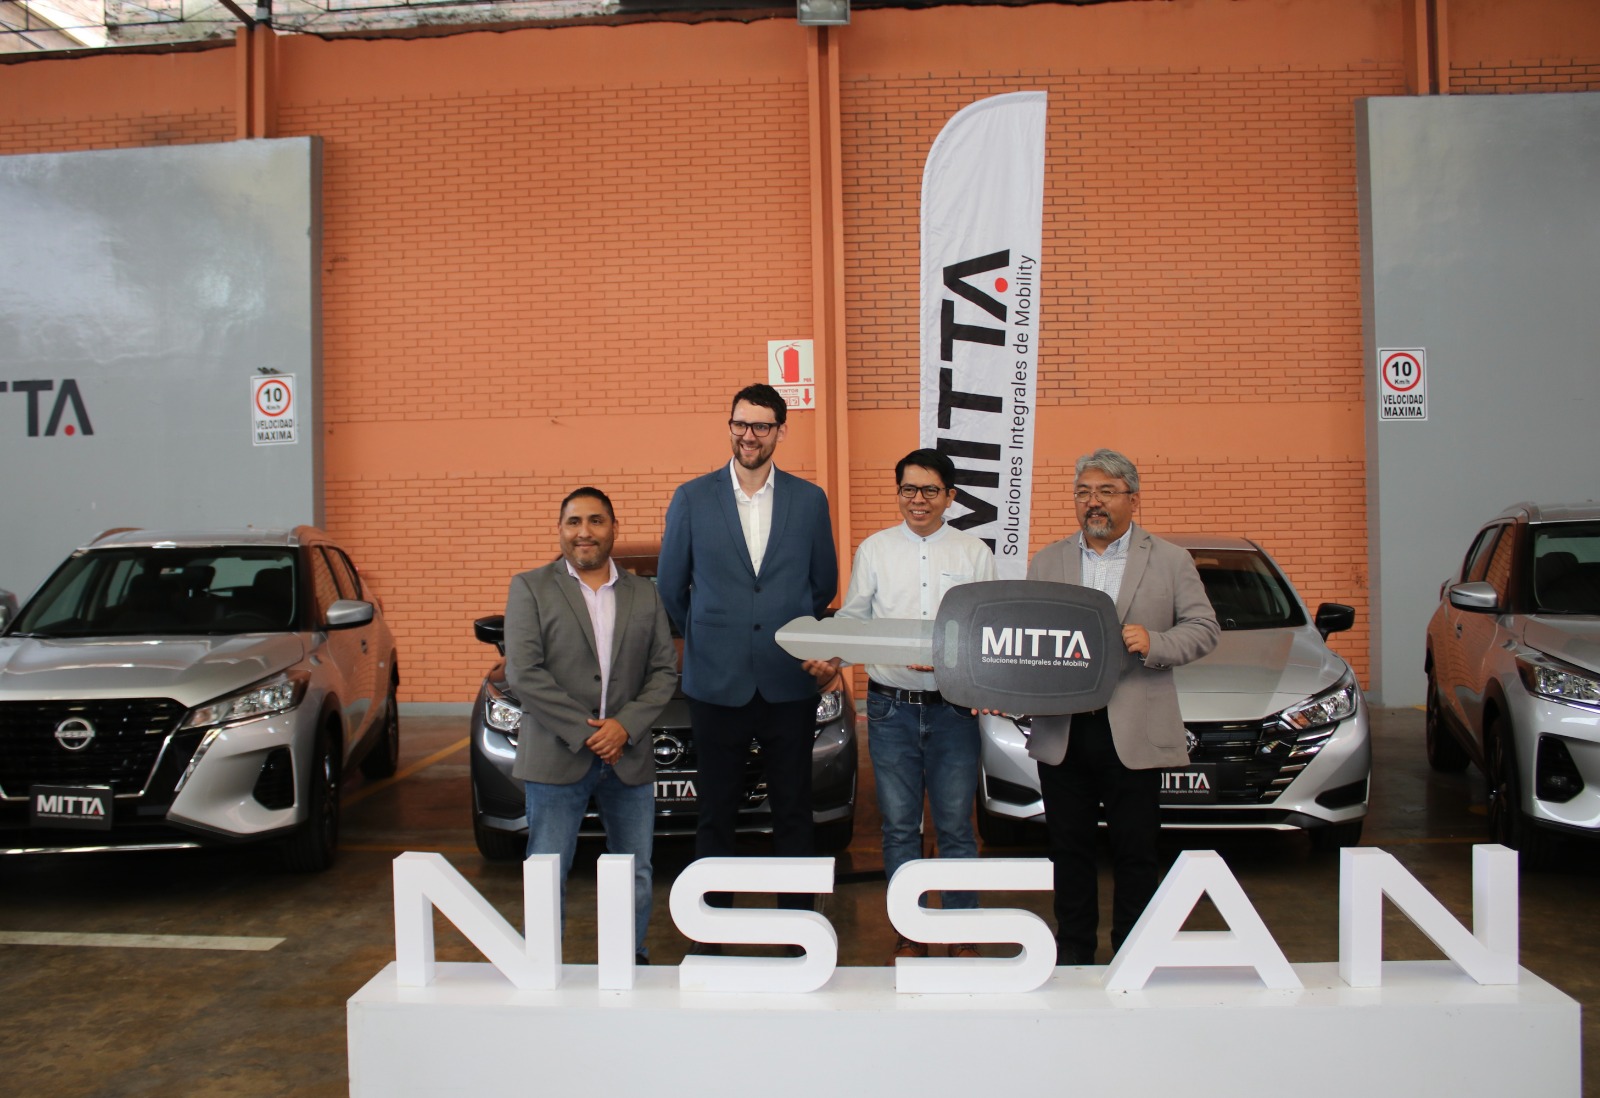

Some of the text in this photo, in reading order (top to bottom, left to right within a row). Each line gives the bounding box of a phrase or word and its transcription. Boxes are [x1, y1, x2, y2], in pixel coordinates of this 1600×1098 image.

[1392, 361, 1412, 377] 10
[264, 387, 283, 402] 10
[1383, 394, 1424, 405] VELOCIDAD
[1003, 254, 1036, 556] Soluciones Integrales de Mobility
[1384, 406, 1423, 417] MAXIMA
[256, 418, 293, 429] VELOCIDAD
[257, 430, 293, 441] MAXIMA
[981, 626, 1092, 660] MITTA
[981, 656, 1018, 665] Soluciones
[1019, 658, 1052, 667] Integrales
[1062, 659, 1090, 669] Mobility
[653, 780, 697, 797] ITTA
[1161, 772, 1210, 789] ITTA
[37, 794, 105, 815] MITTA
[393, 844, 1520, 994] NISSAN
